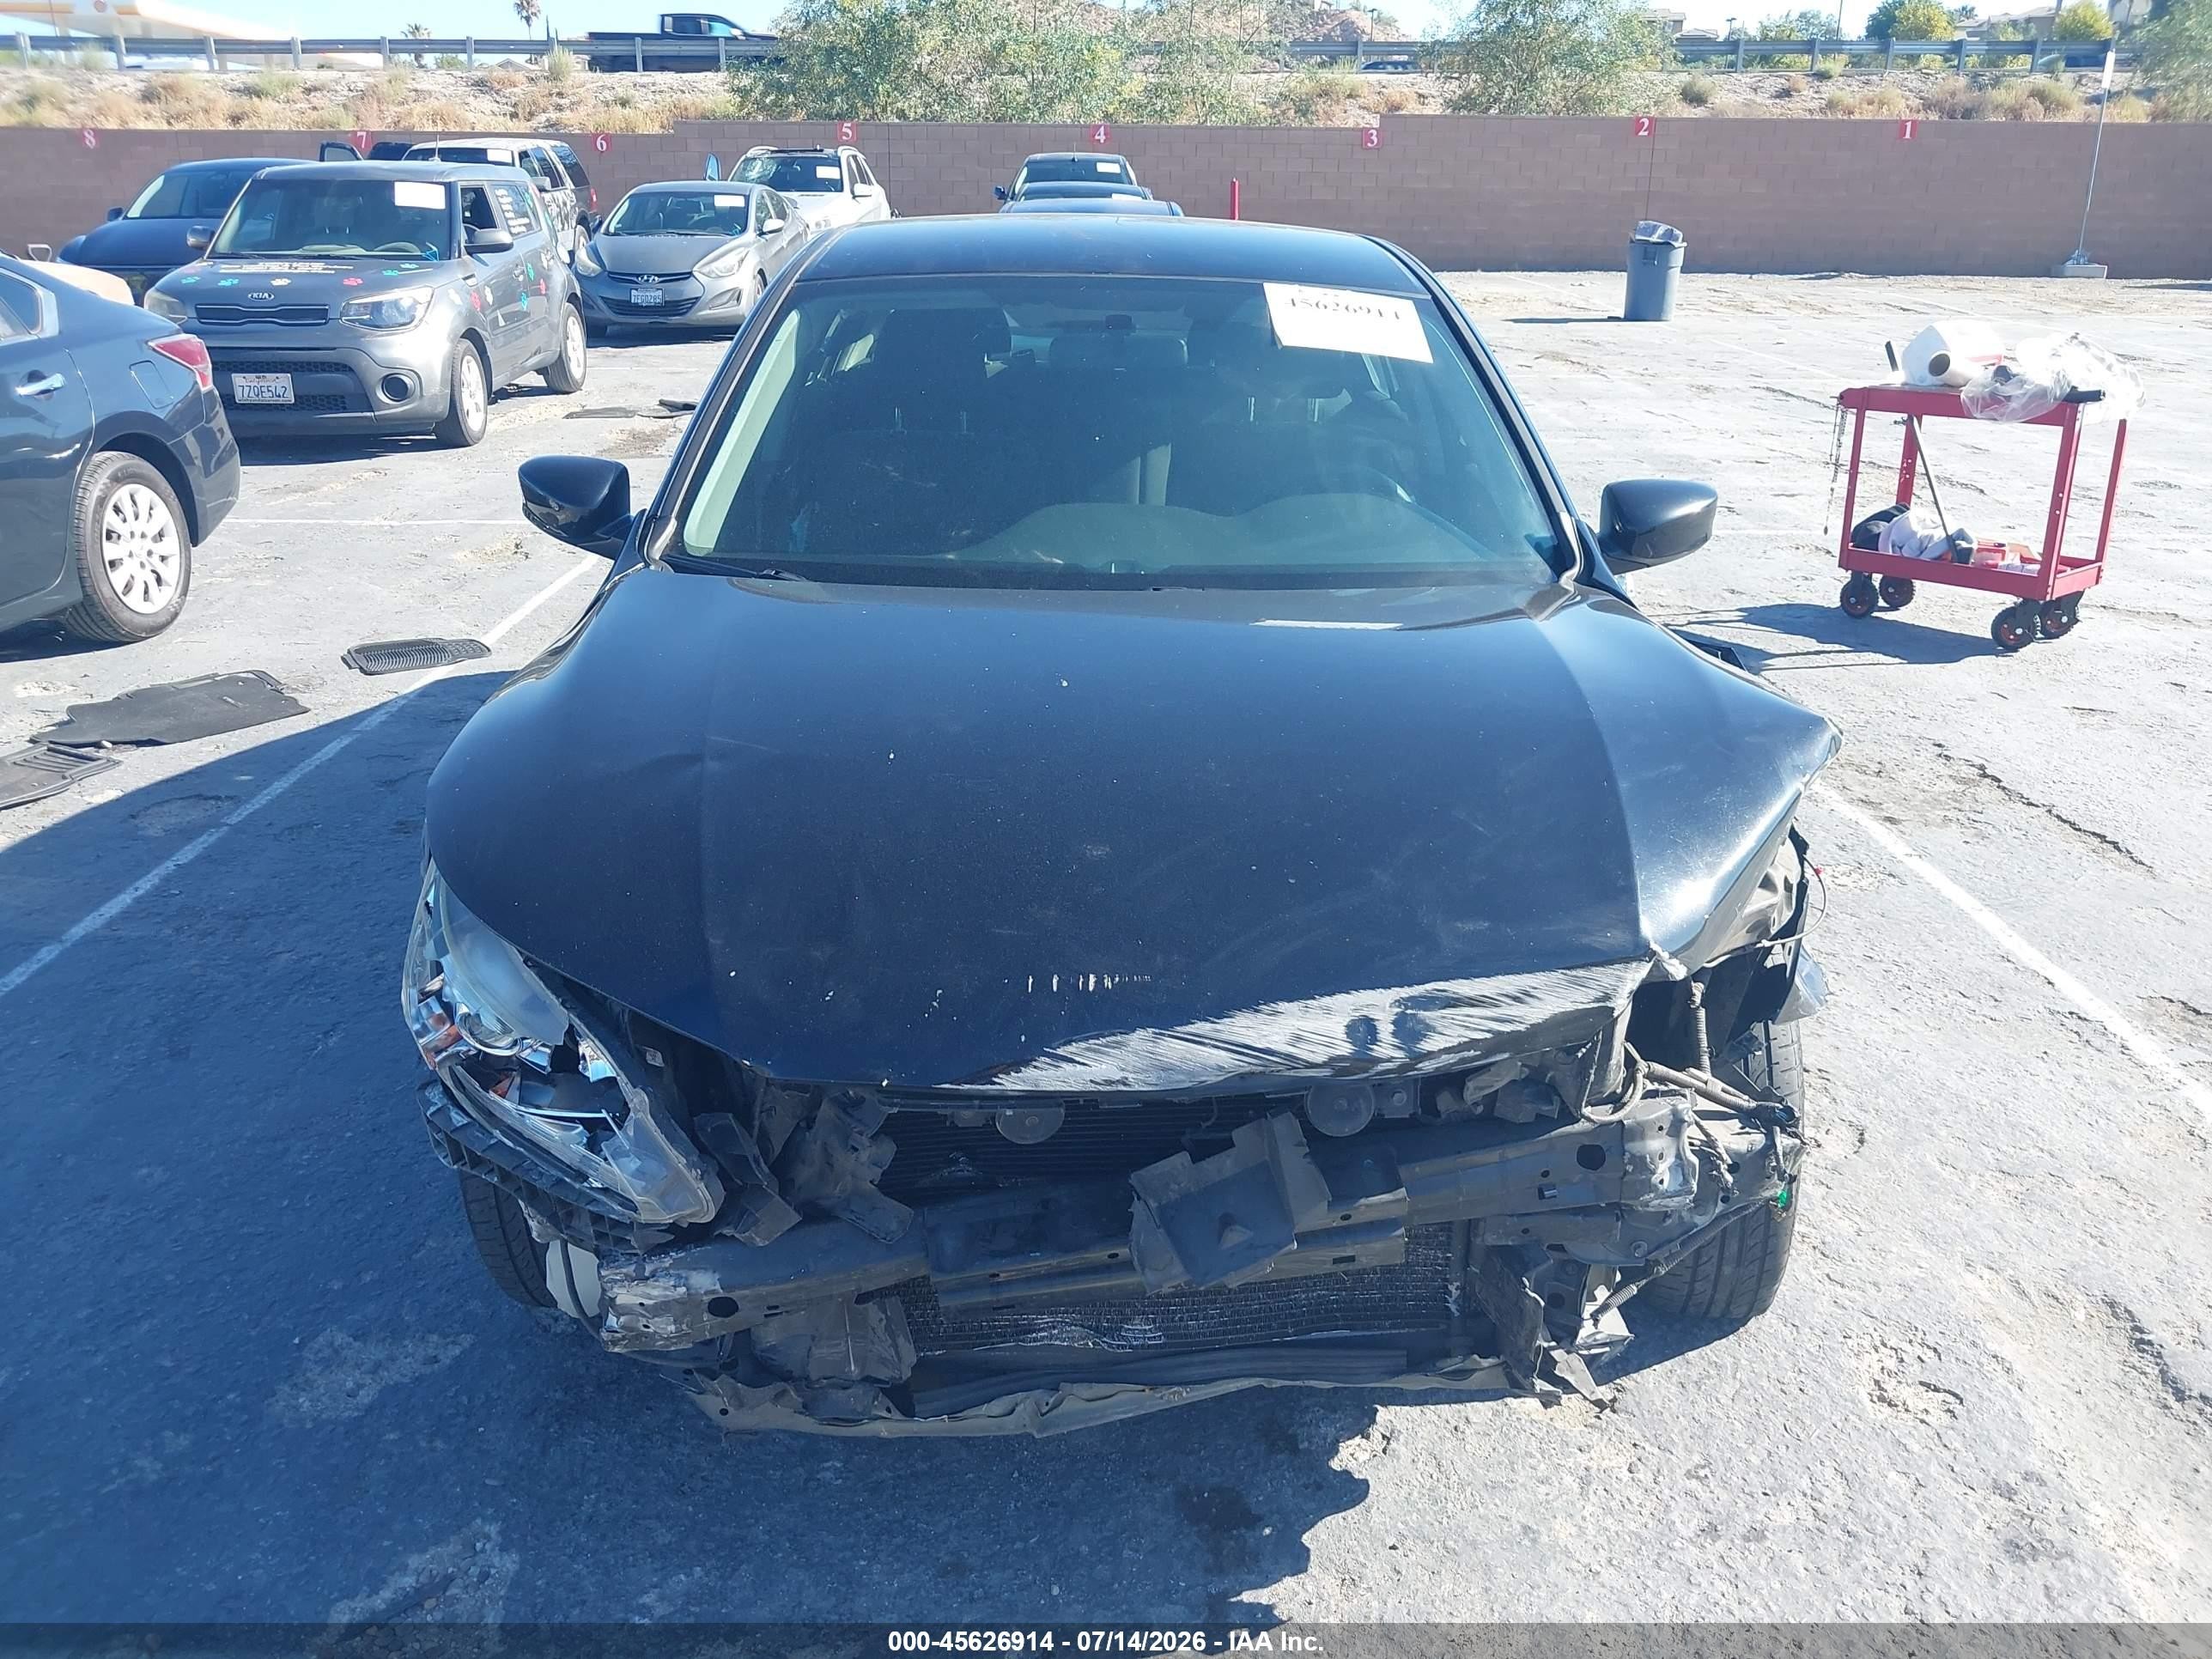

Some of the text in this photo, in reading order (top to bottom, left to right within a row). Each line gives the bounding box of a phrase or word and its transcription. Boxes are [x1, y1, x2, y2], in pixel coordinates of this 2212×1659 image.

[842, 122, 853, 140] 5
[1094, 125, 1106, 143] 4
[1638, 118, 1650, 136] 2
[1902, 120, 1912, 139] 1
[83, 129, 95, 149] 8
[356, 131, 367, 149] 7
[596, 134, 607, 152] 6
[1366, 129, 1378, 146] 3
